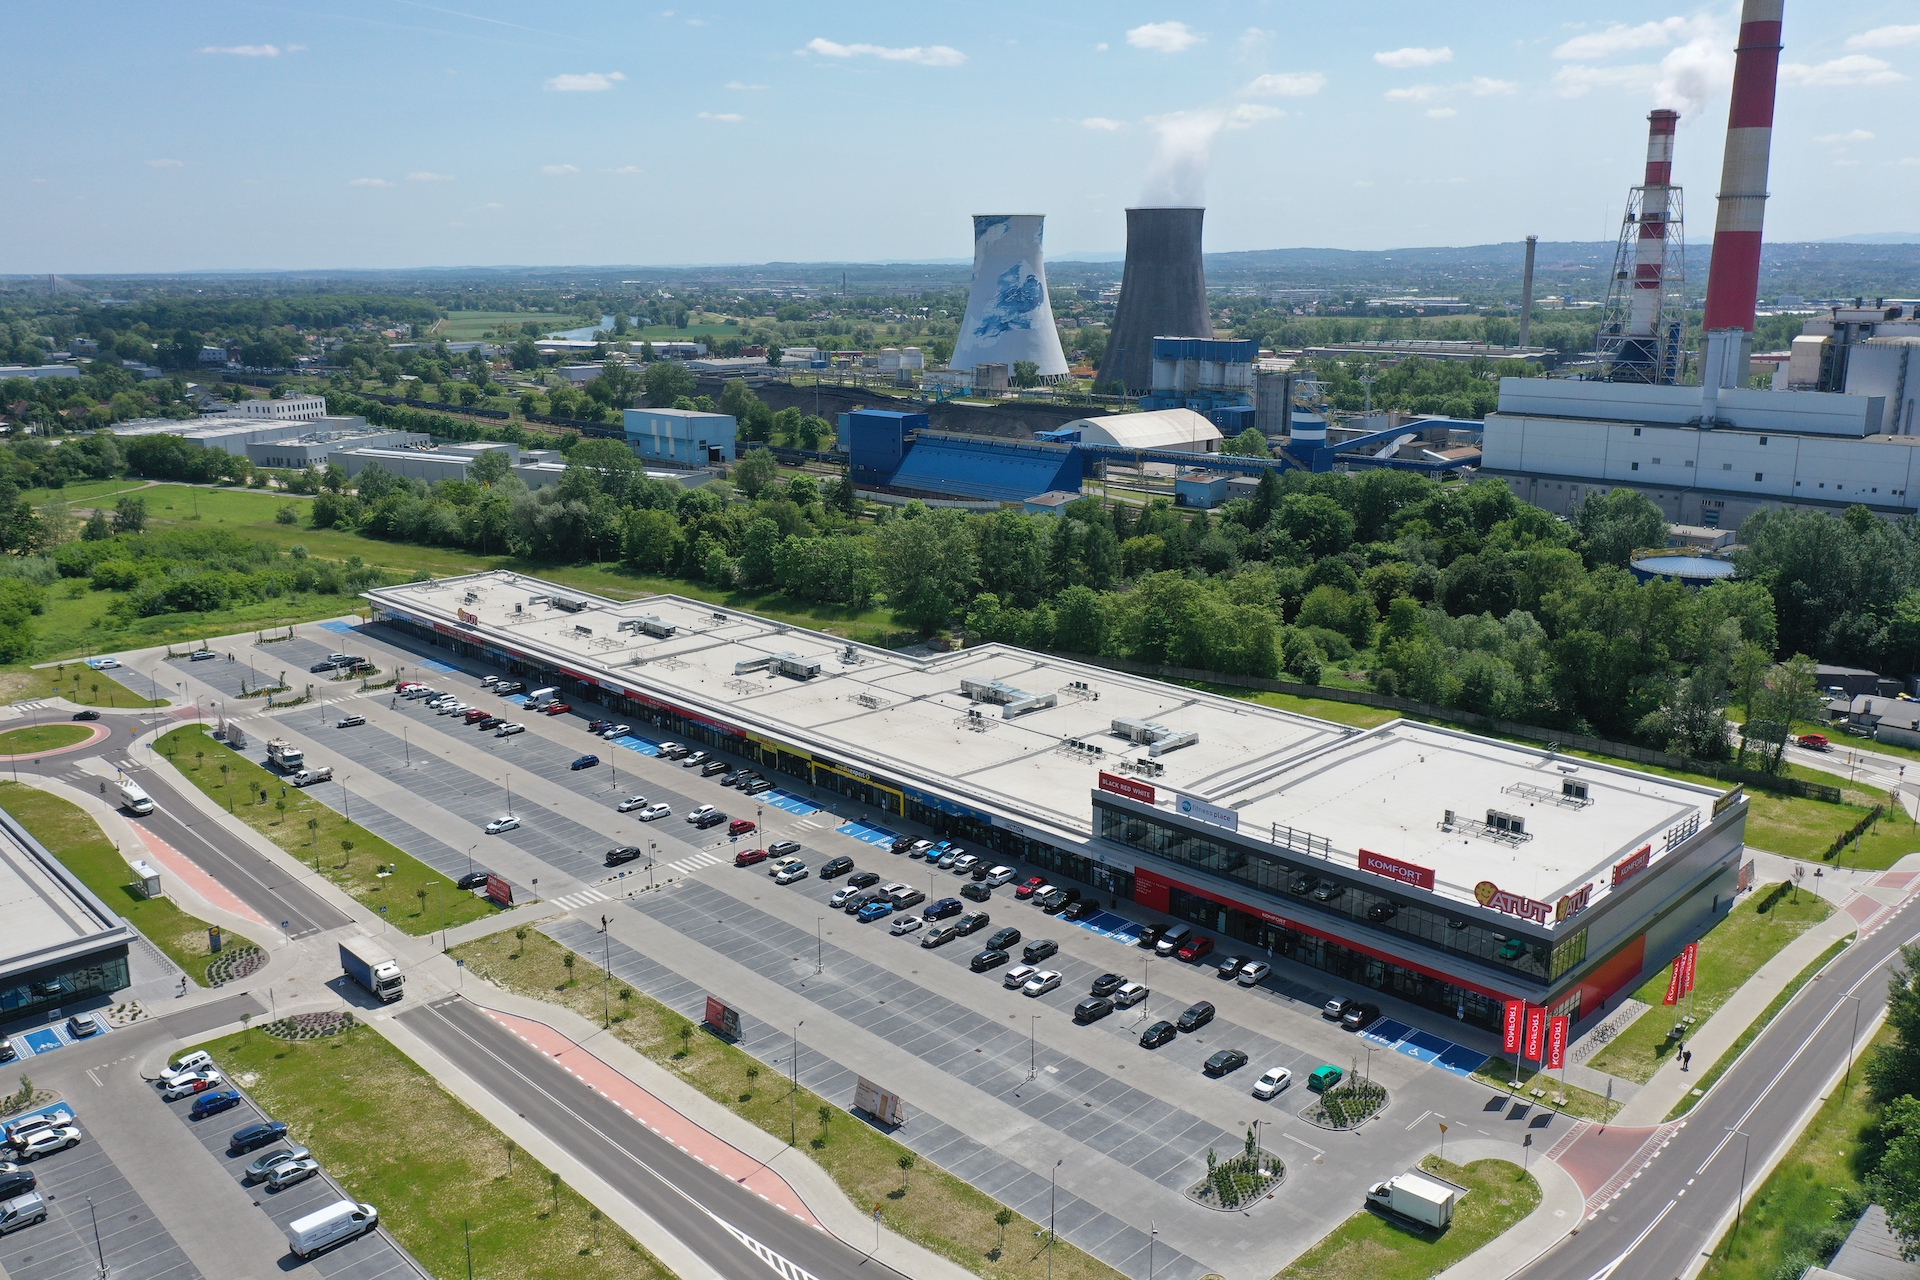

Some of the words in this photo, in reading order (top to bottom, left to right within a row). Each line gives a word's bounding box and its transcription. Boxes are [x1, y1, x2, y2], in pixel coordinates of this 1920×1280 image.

[1102, 778, 1119, 789] BLACK
[1120, 783, 1131, 792] RED
[1132, 787, 1150, 798] WHITE
[1192, 804, 1213, 816] fitness
[1213, 811, 1231, 821] place
[1368, 858, 1422, 880] KOMFORT
[1620, 854, 1646, 876] KOMFORT
[1402, 876, 1420, 884] HOME
[1488, 891, 1552, 922] ATUT
[1564, 886, 1593, 917] ATUT
[1261, 912, 1287, 924] KOMFORT
